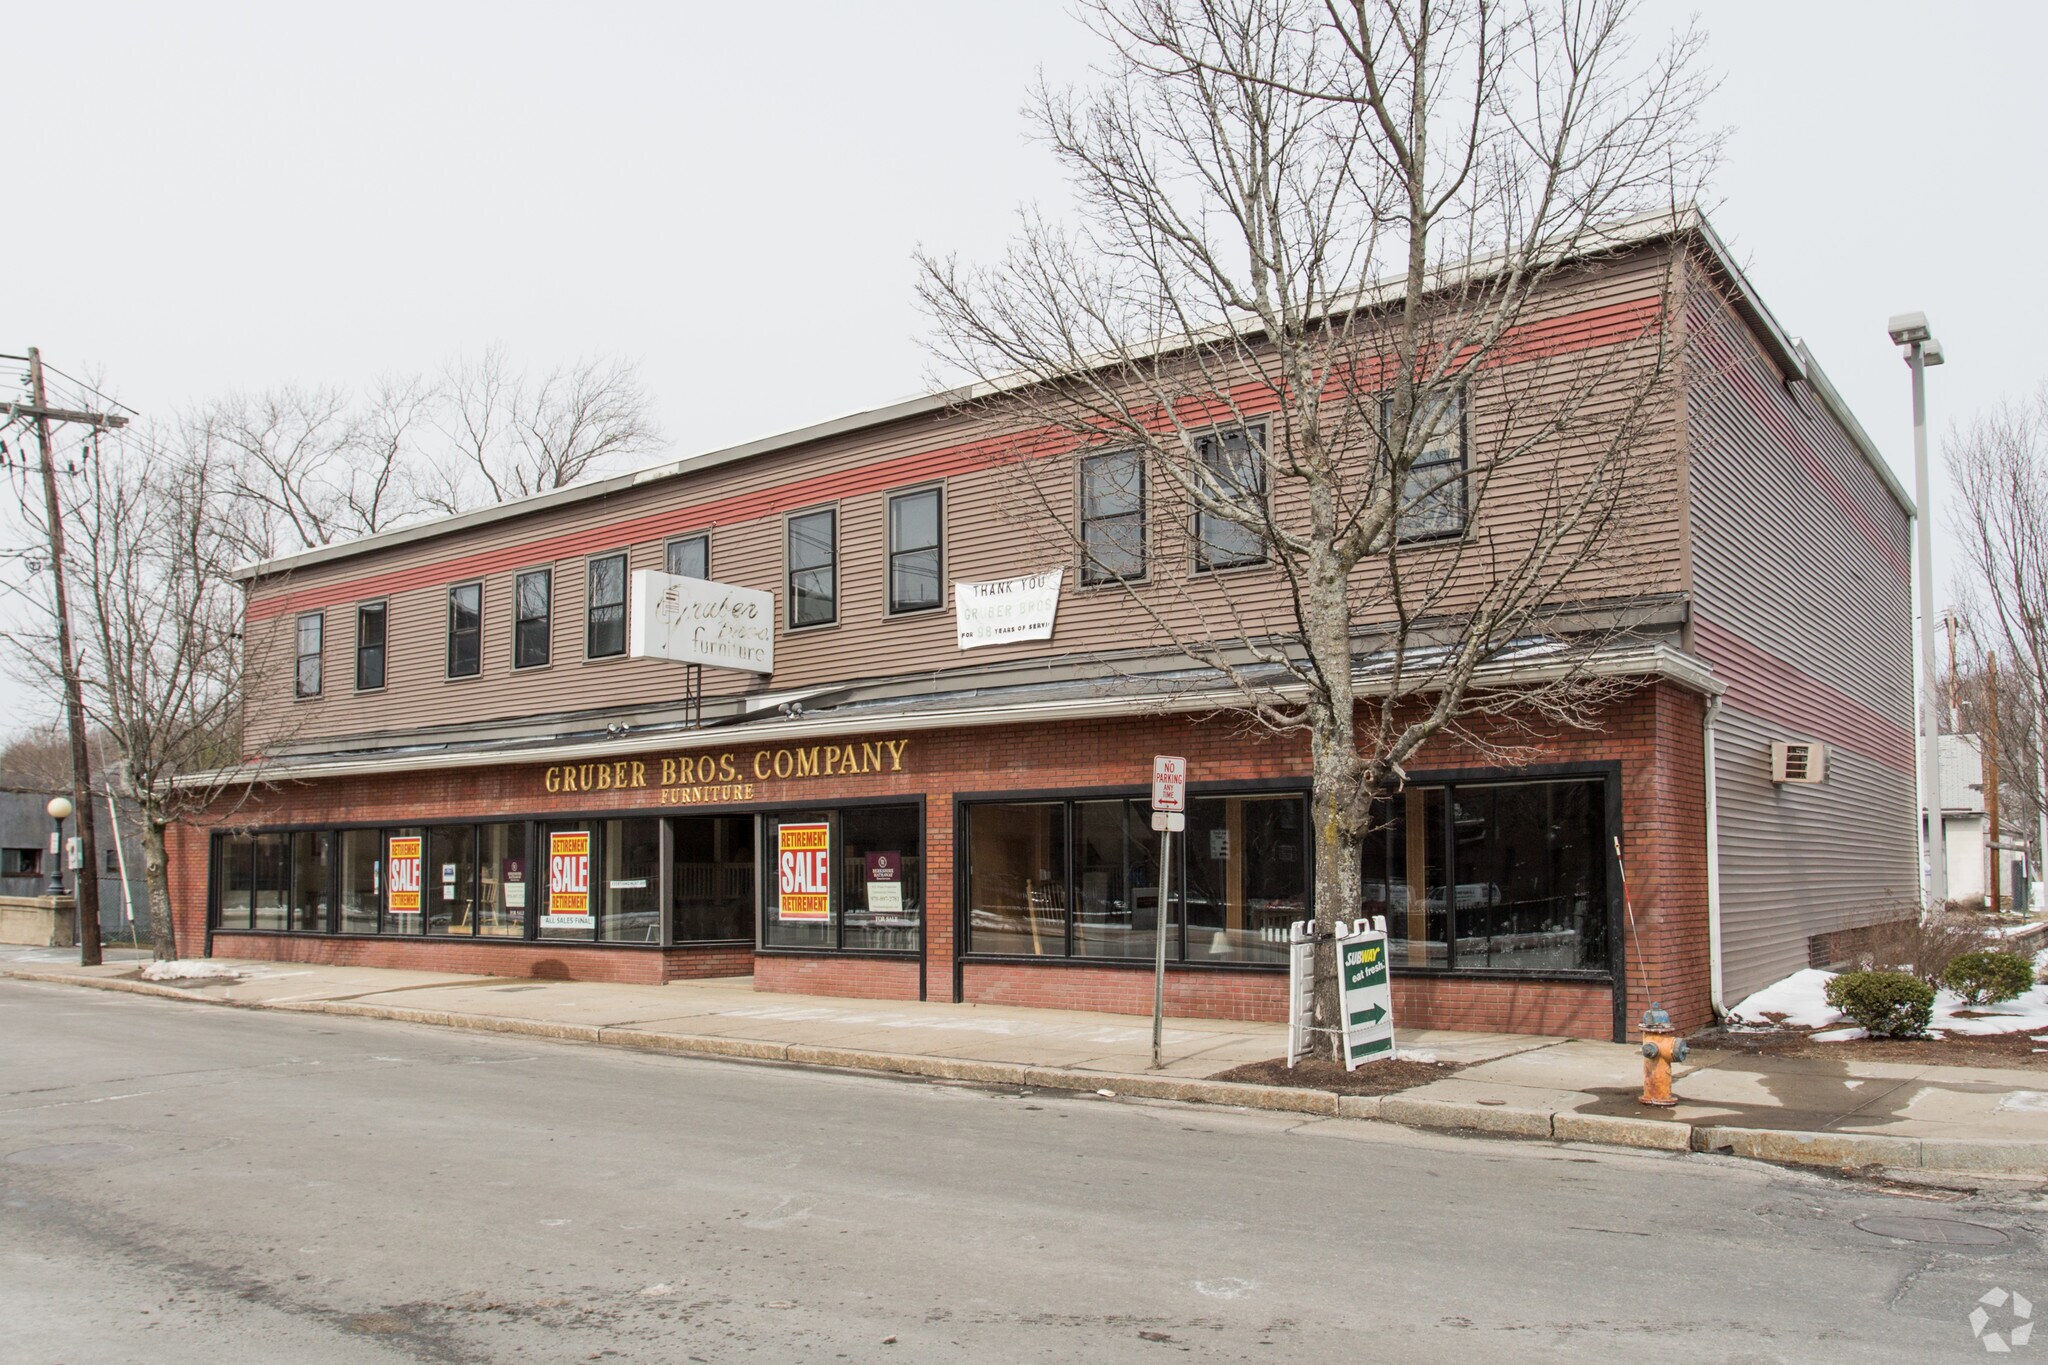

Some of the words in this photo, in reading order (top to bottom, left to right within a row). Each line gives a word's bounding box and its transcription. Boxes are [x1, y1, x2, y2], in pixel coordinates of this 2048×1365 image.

[973, 581, 1013, 598] THANK
[1021, 575, 1046, 592] YOU
[964, 604, 1013, 621] GRUBER
[1019, 598, 1052, 615] BROS
[961, 631, 974, 639] FOR
[994, 626, 1015, 635] YEARS
[1028, 621, 1050, 630] SERVI
[692, 626, 765, 662] furniture
[545, 761, 647, 793] GRUBER
[660, 752, 743, 786] BROS.
[753, 739, 908, 780] COMPANY
[1164, 763, 1175, 773] NO
[1156, 773, 1182, 784] PARKING
[660, 783, 754, 804] FURNITURE
[552, 839, 588, 853] RETIREMENT
[781, 831, 827, 848] RETIREMENT
[391, 843, 420, 856] RETIREMENT
[391, 858, 420, 892] SALE
[552, 856, 588, 893] SALE
[781, 851, 827, 894] SALE
[391, 894, 419, 906] RETIREMENT
[552, 895, 587, 909] RETIREMENT
[781, 896, 828, 912] RETIREMENT
[545, 916, 555, 924] ALL
[556, 916, 574, 925] SALES
[1345, 947, 1380, 967] SUBWAY
[1352, 970, 1365, 983] eat
